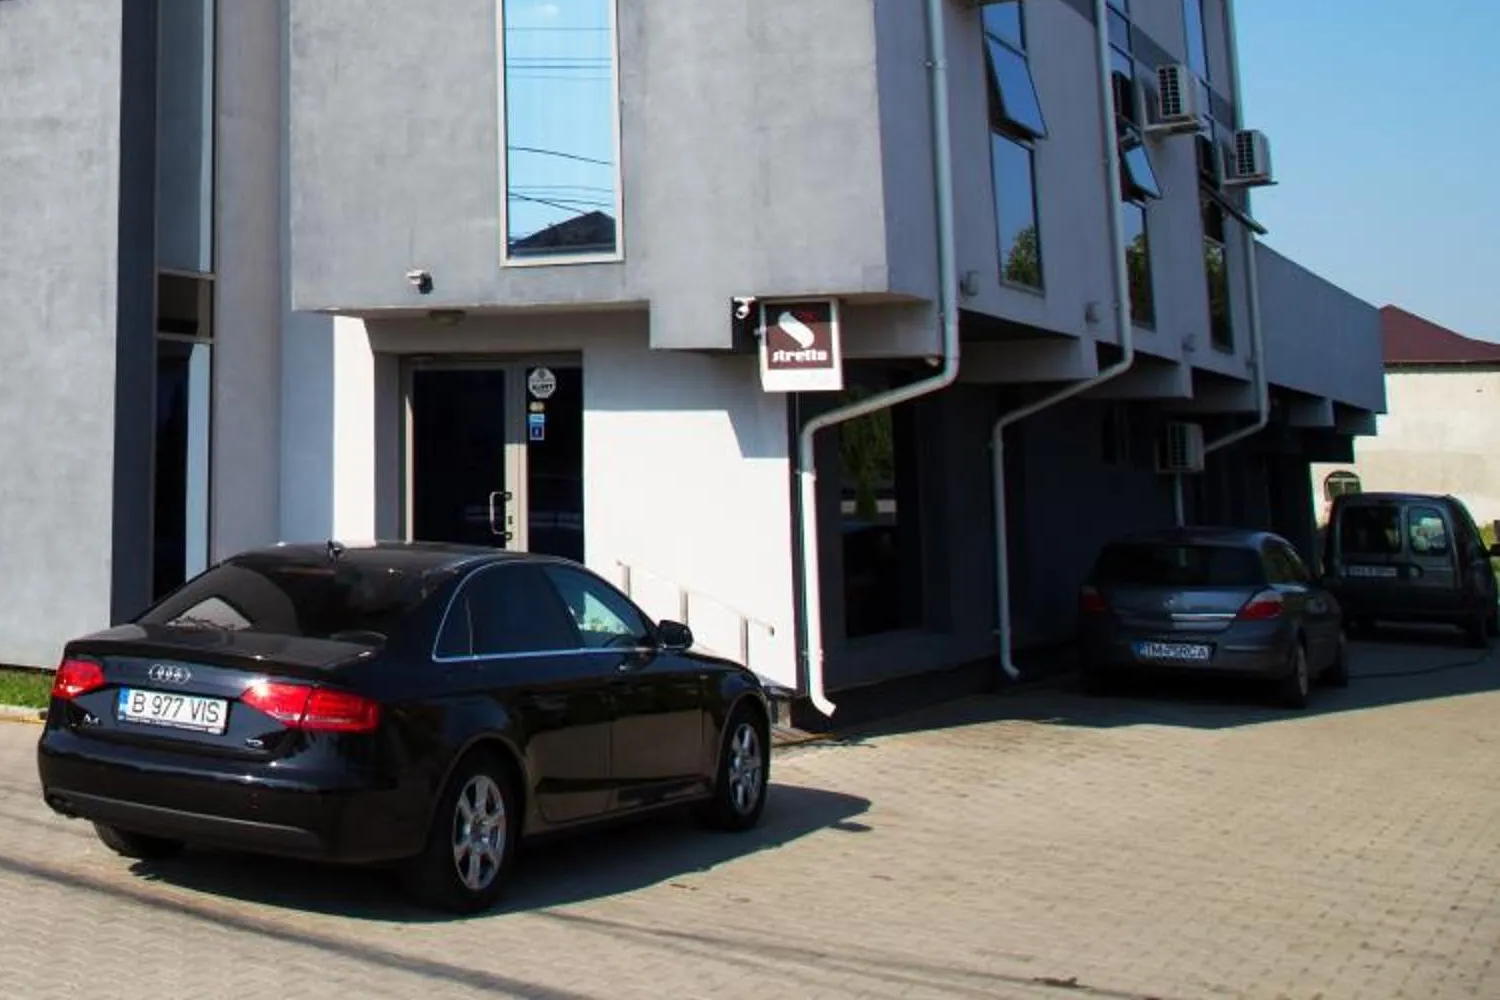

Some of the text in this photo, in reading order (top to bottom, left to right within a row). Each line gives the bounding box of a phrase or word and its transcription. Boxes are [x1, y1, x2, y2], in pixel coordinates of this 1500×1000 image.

[771, 349, 828, 363] stretto
[132, 692, 221, 723] B 977 VIS
